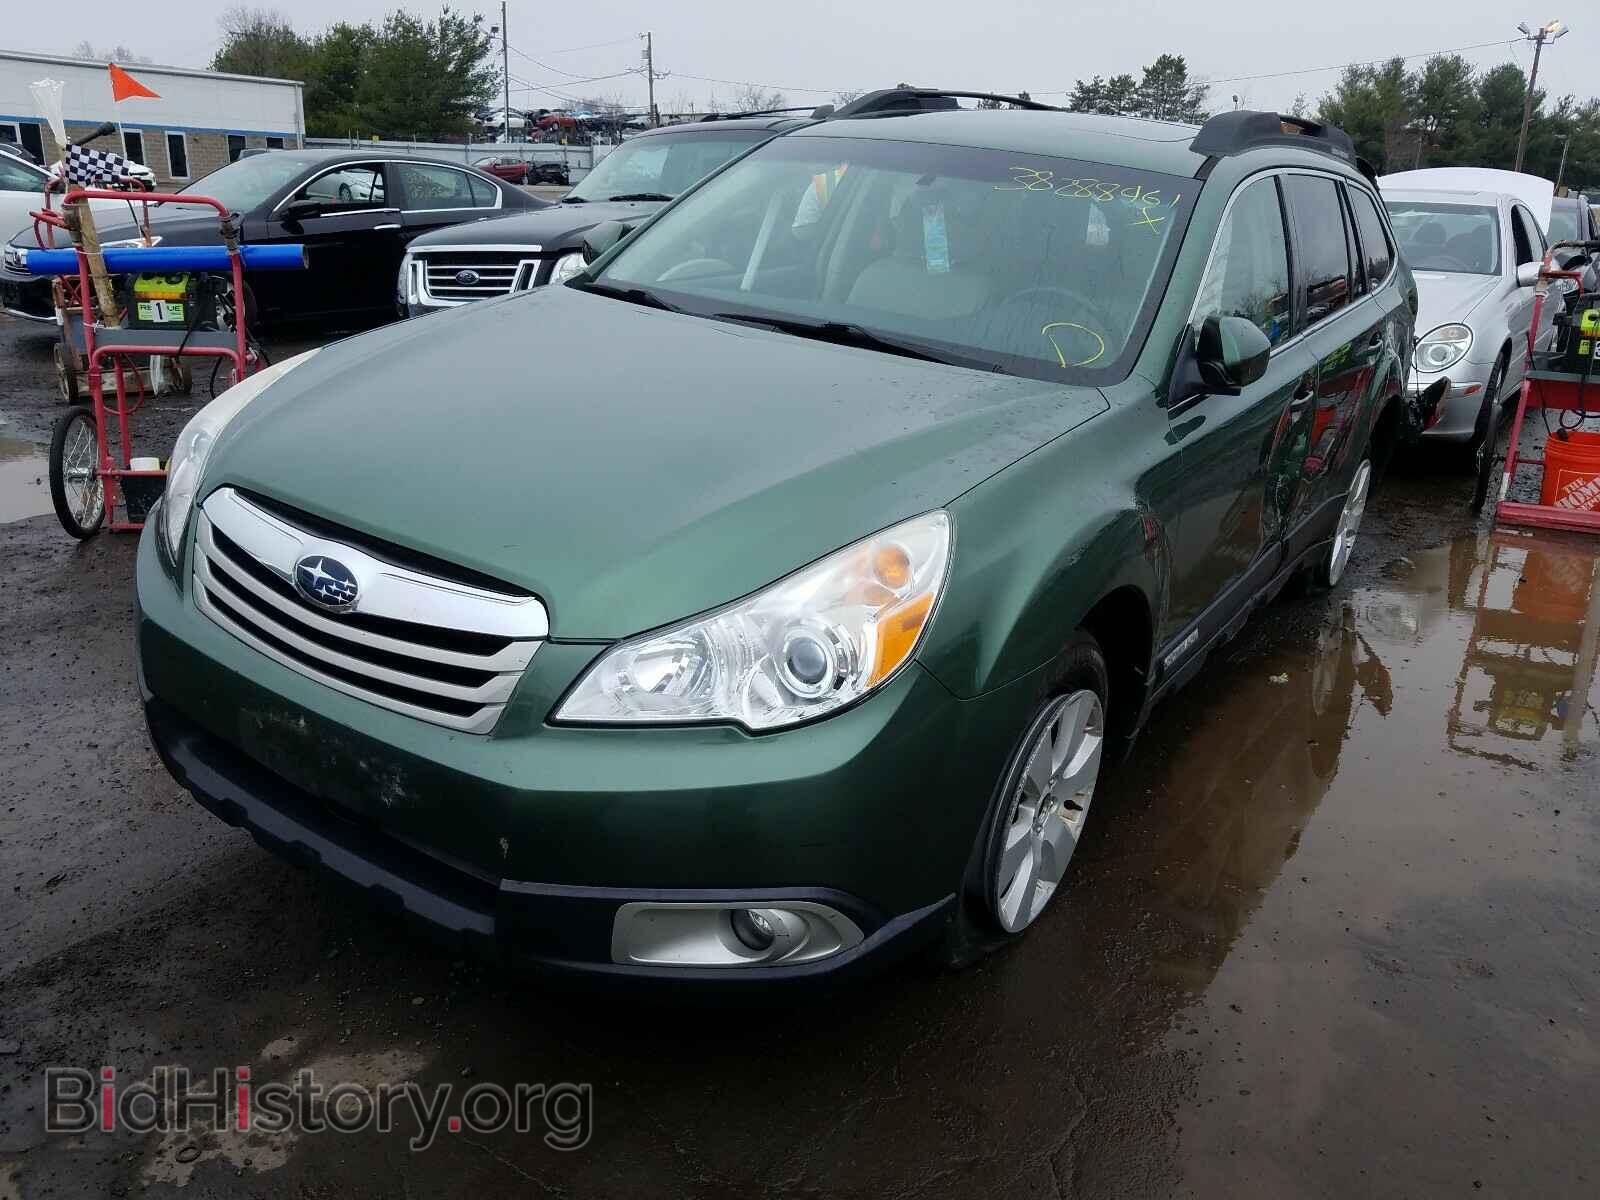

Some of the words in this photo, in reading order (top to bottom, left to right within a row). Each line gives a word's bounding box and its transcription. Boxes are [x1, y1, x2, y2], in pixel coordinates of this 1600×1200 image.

[140, 304, 183, 312] REUE
[155, 302, 163, 320] 1
[1562, 477, 1585, 493] THE
